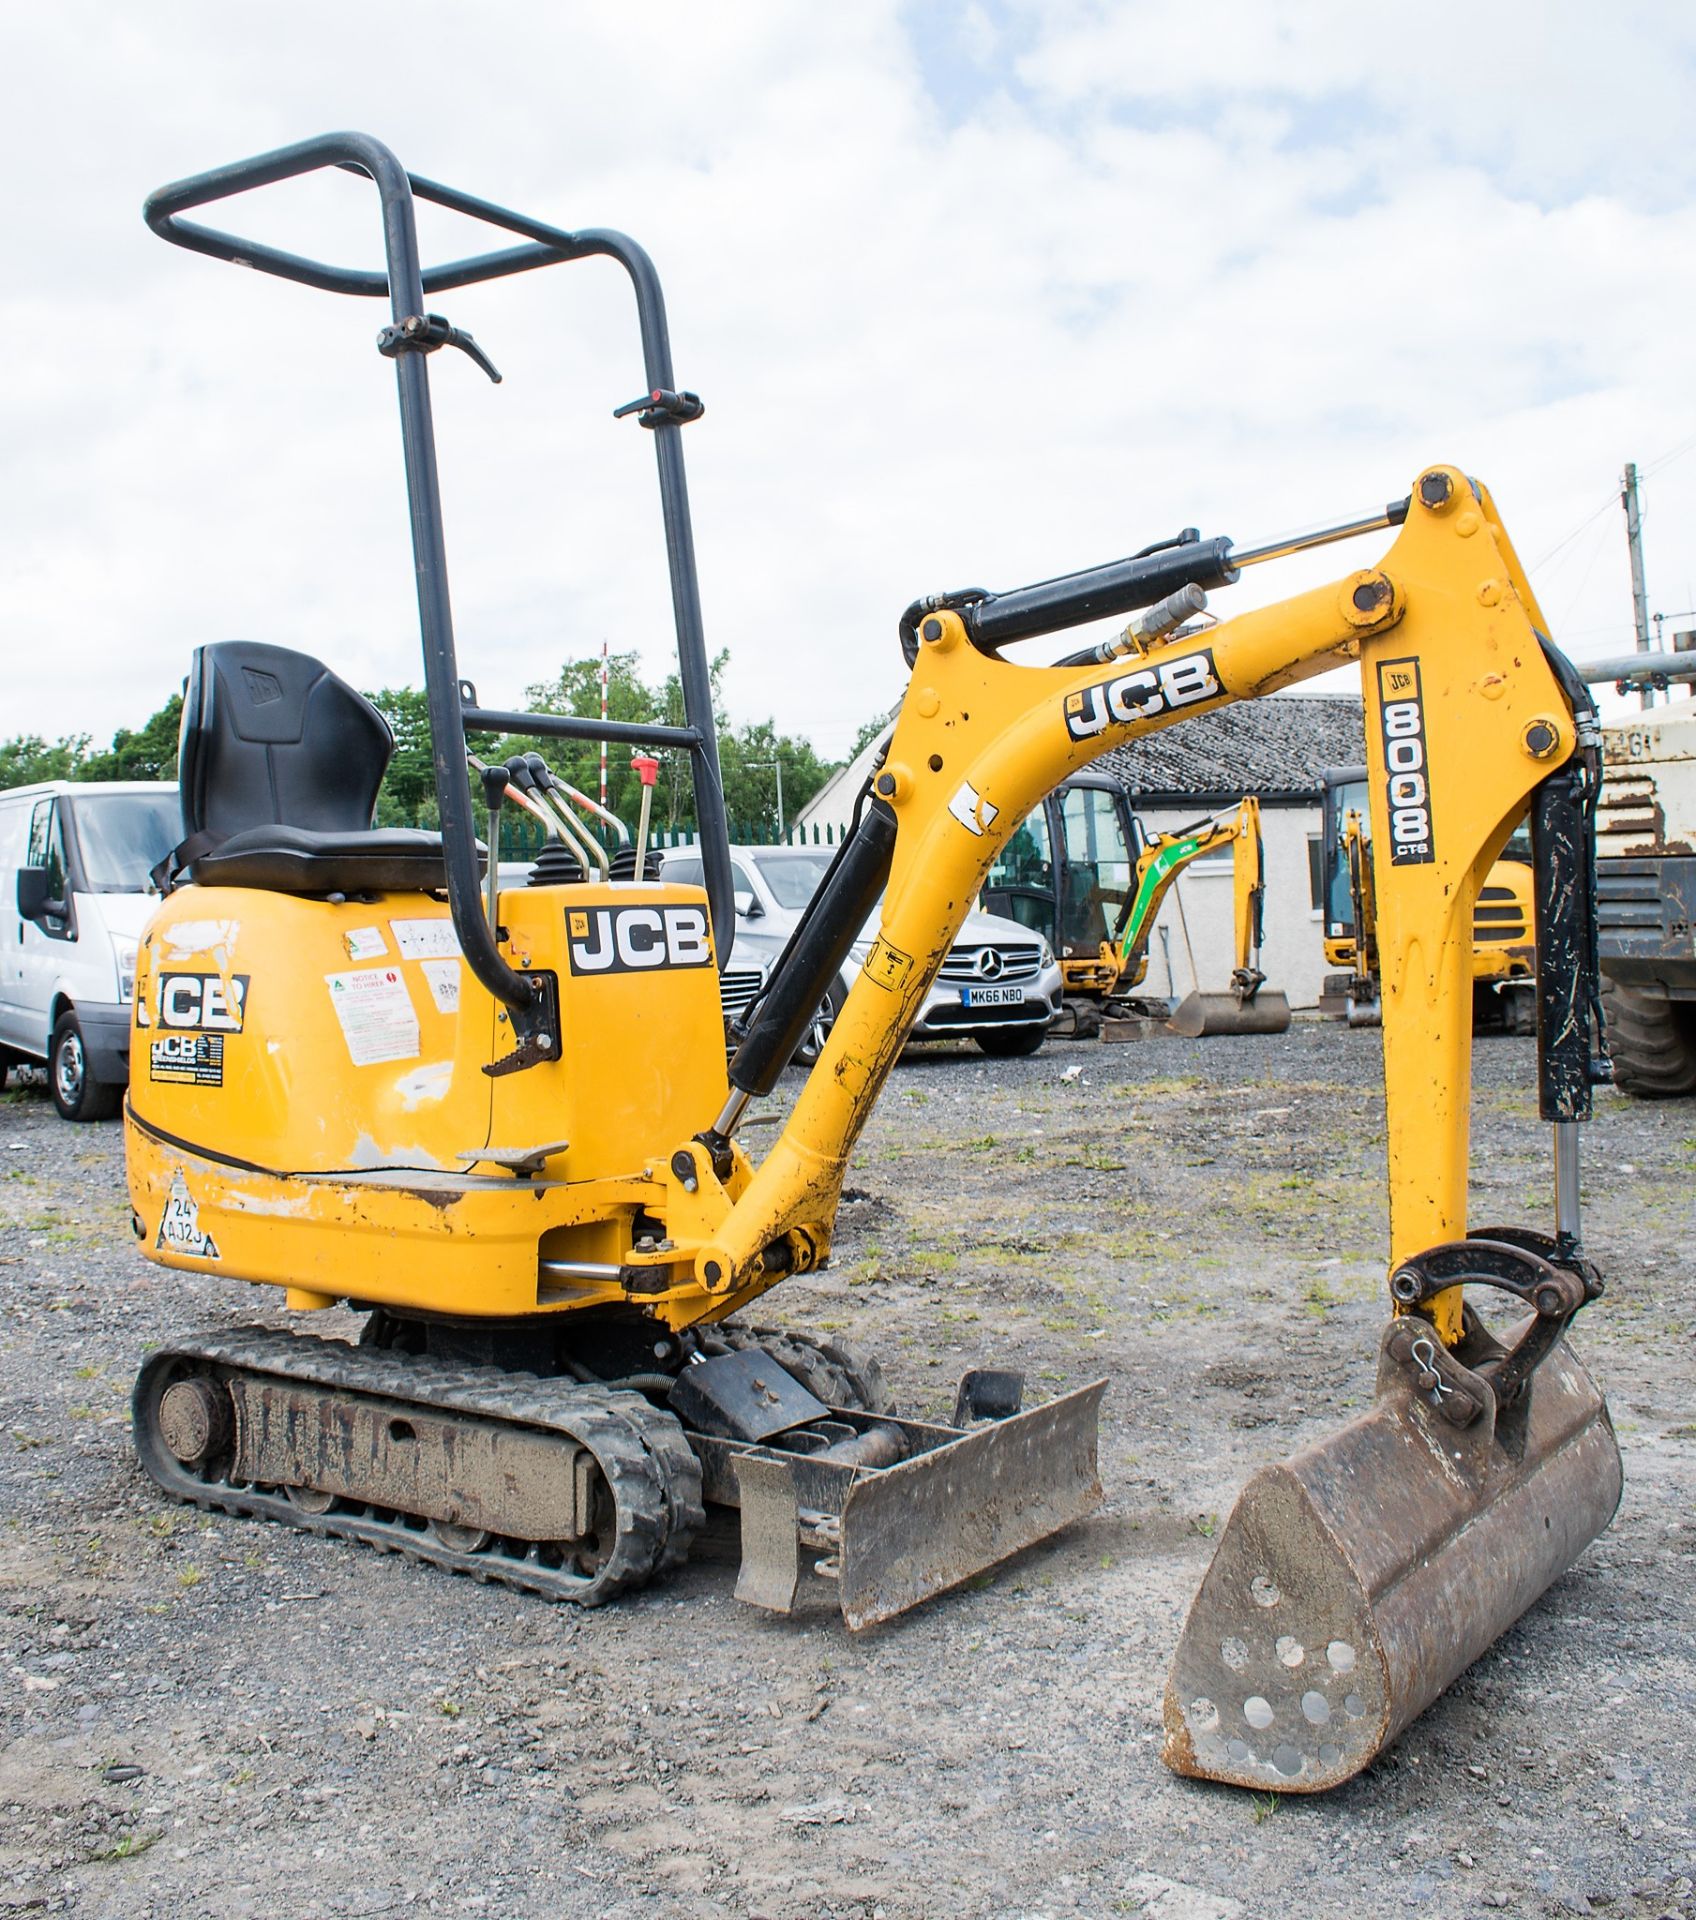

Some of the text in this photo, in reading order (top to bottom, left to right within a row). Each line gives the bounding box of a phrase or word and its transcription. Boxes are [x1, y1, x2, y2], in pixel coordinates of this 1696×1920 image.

[1069, 655, 1218, 736] JCB
[1391, 674, 1411, 690] JCB
[1385, 702, 1429, 843] 8008
[573, 909, 710, 970] JCB
[971, 989, 1022, 1003] MK66 NBO
